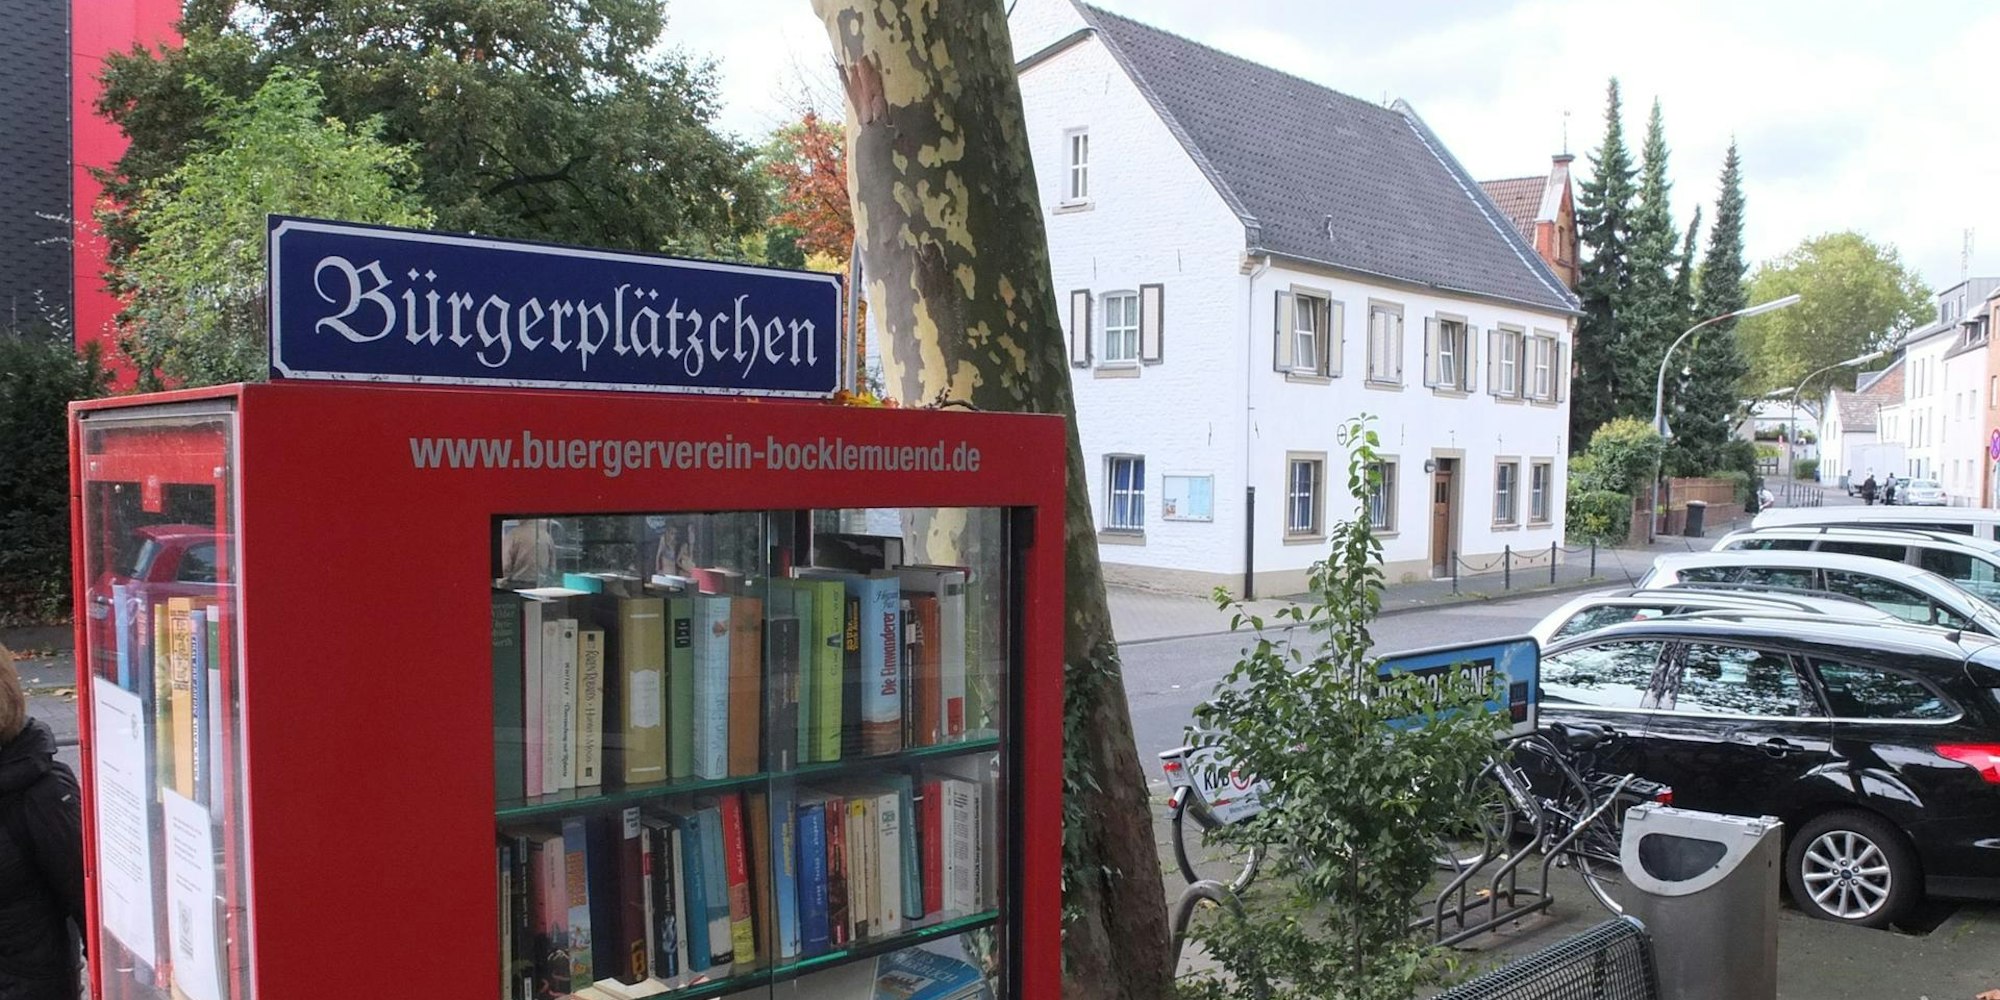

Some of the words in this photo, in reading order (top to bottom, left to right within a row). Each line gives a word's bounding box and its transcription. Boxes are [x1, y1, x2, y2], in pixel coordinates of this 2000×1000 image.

[313, 255, 818, 378] Bürgerplätzchen
[409, 430, 981, 478] www.buergerverein-bocklemuend.de
[880, 612, 897, 677] Einwanderer
[881, 677, 897, 696] Die
